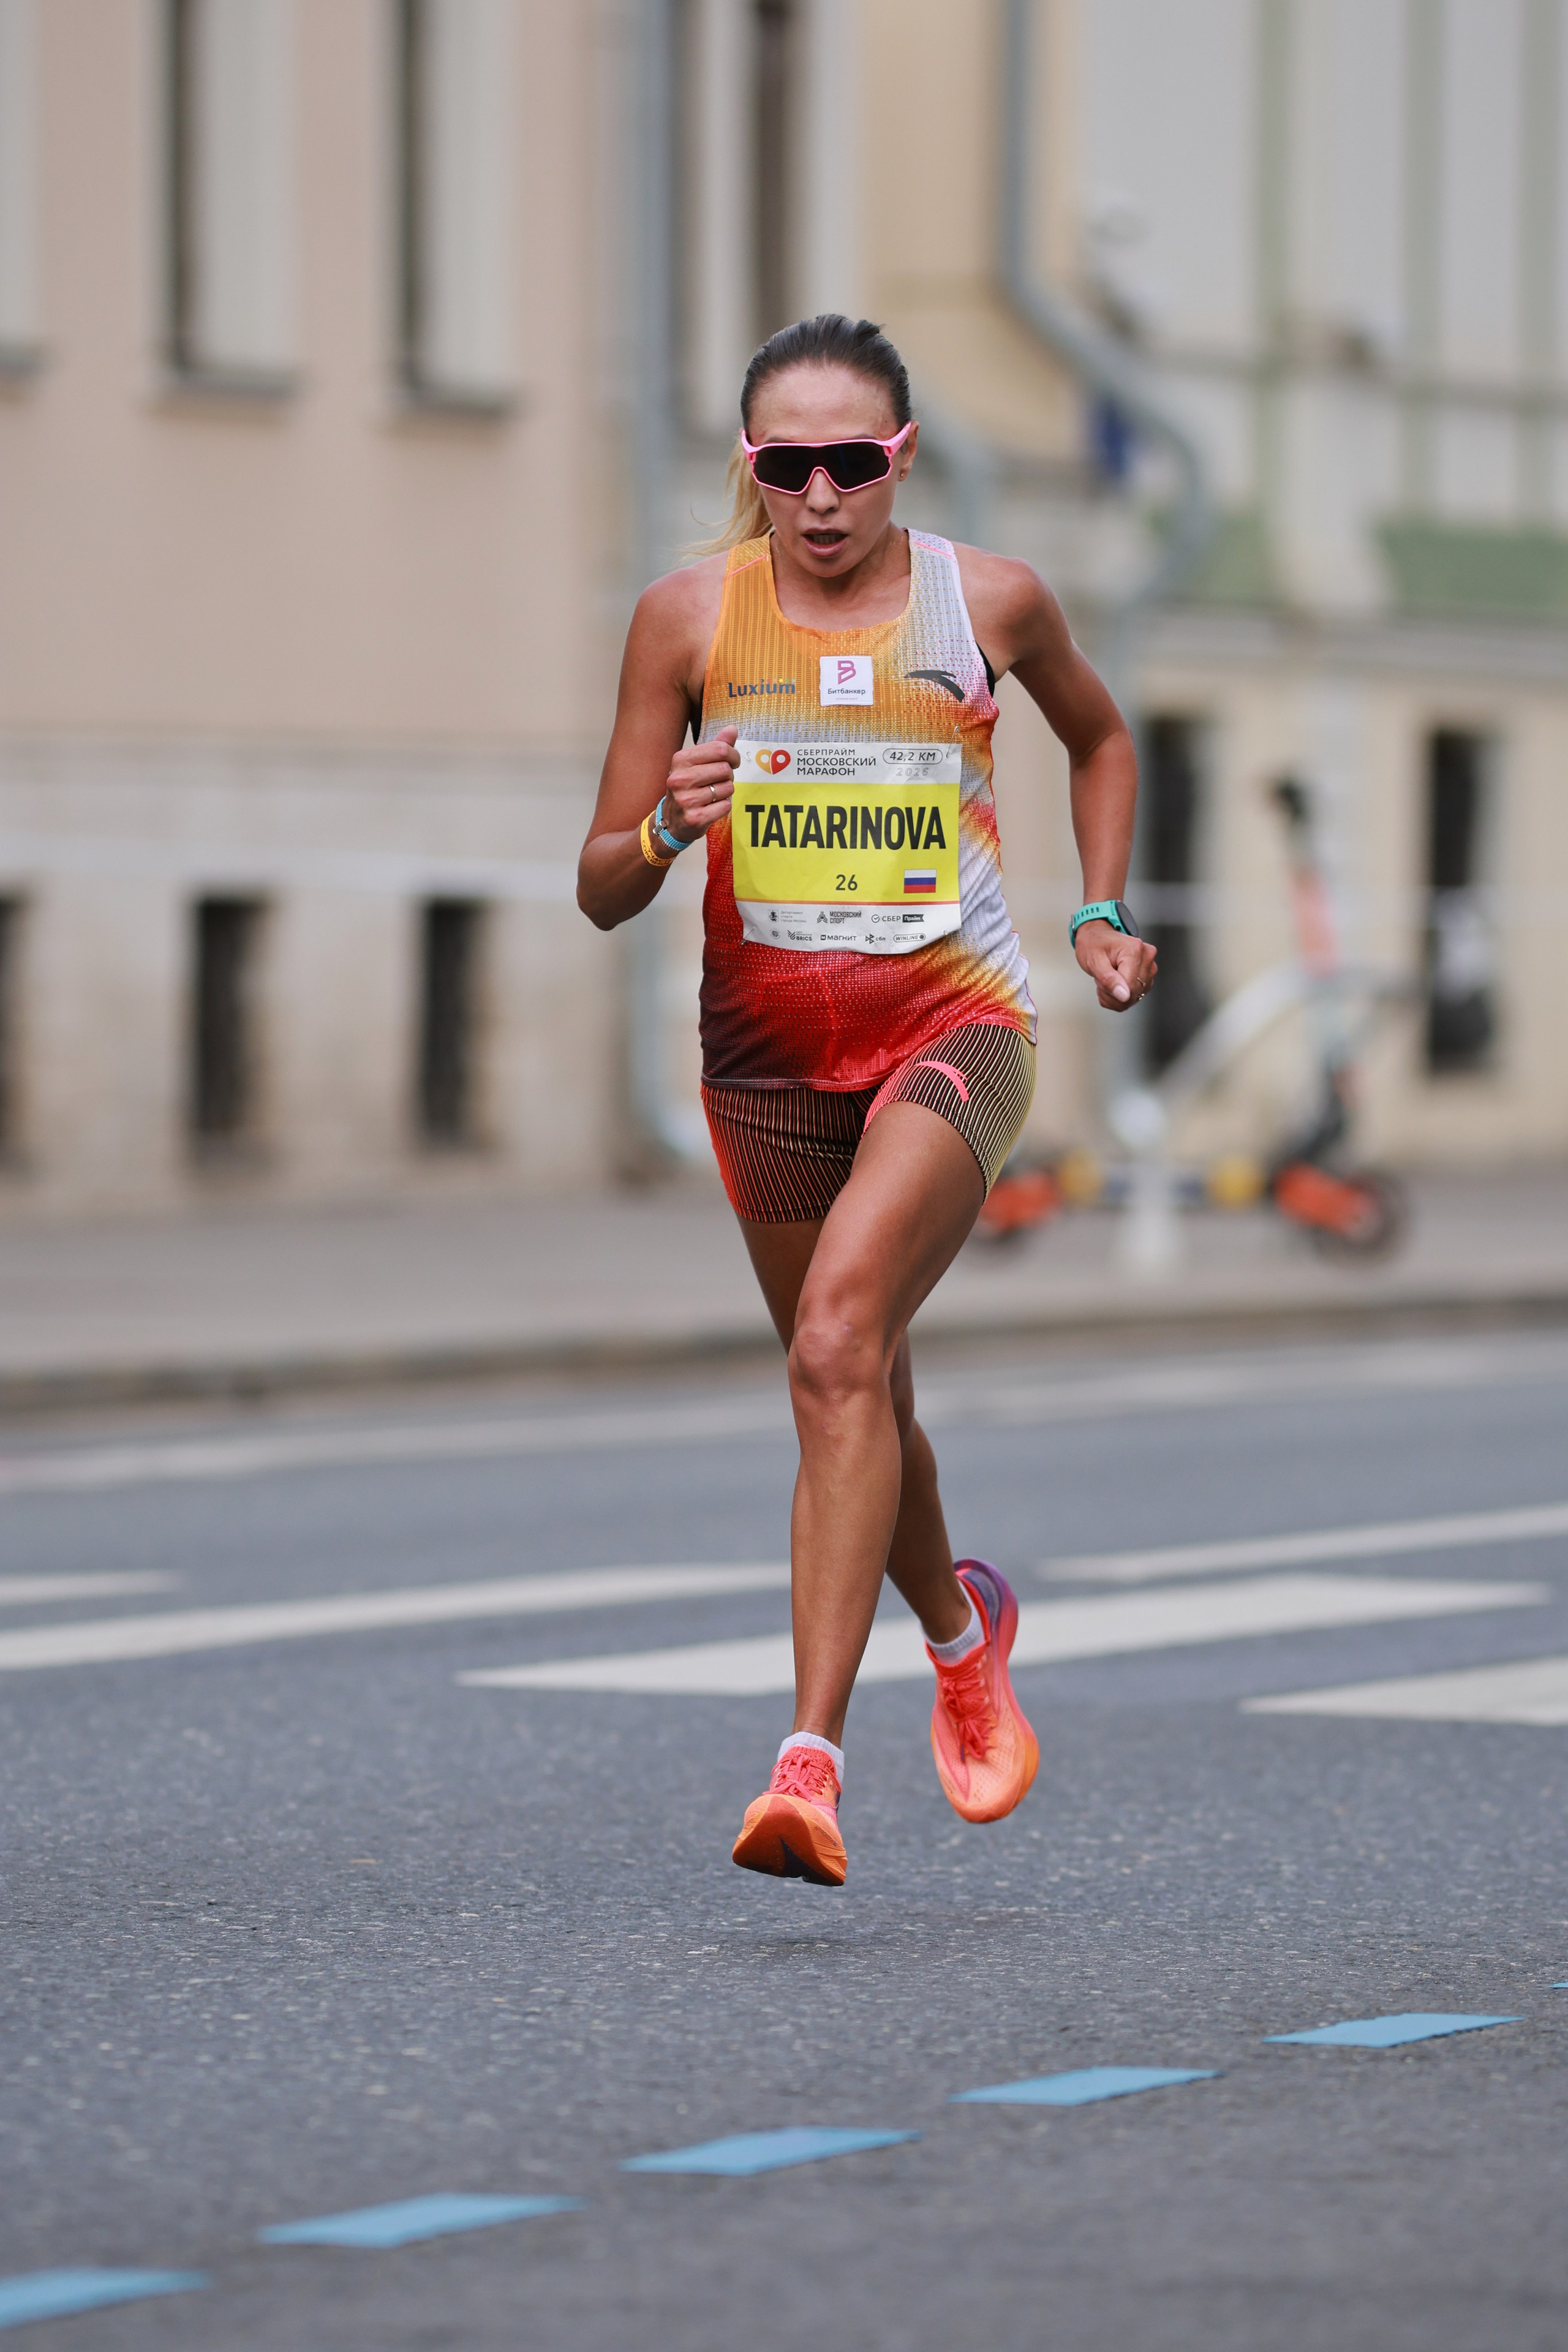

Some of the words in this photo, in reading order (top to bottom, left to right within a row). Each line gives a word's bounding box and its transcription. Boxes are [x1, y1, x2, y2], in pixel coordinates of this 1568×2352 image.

[728, 679, 796, 698] Luxium
[797, 756, 876, 766] МОСКОВСКИЙ
[889, 752, 914, 761] 42,2
[797, 767, 855, 776] МАРАФОН
[896, 767, 929, 777] 2026
[745, 804, 946, 850] TATARINOVA
[835, 874, 858, 891] 26
